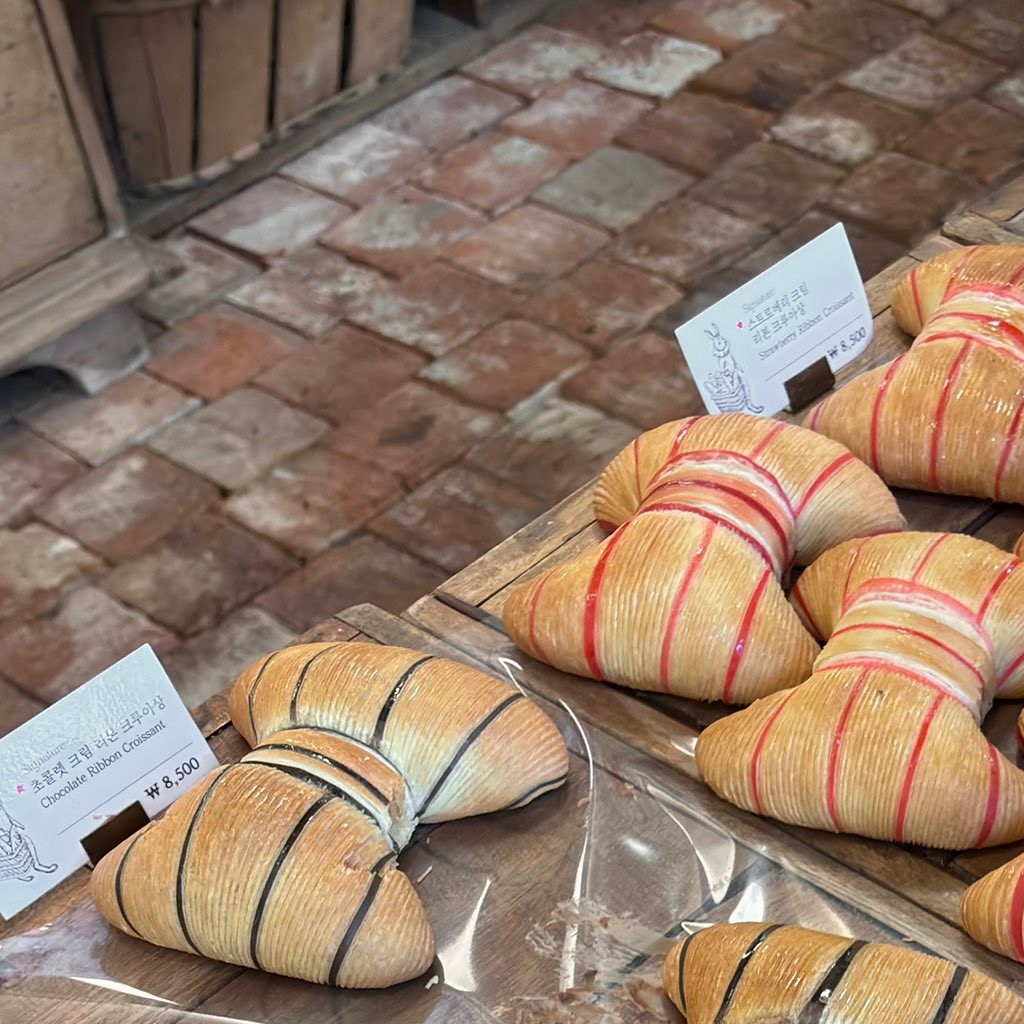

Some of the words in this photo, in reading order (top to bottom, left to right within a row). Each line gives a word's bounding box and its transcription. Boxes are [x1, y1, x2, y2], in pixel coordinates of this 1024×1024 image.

[792, 282, 809, 302] 크림
[752, 327, 771, 344] 리본
[772, 303, 805, 333] 크루아상
[759, 332, 797, 361] Strawberry
[798, 315, 823, 335] Ribbon
[823, 292, 855, 317] Croissant
[840, 327, 866, 352] 8,500
[23, 743, 67, 772] Signature
[31, 762, 68, 793] 초콜렛
[68, 744, 93, 768] 크림
[94, 730, 119, 749] 리본
[121, 695, 166, 733] 크루아상
[41, 773, 87, 809] Chocolate
[87, 751, 122, 777] Ribbon
[123, 720, 166, 753] Croissant
[163, 757, 199, 789] 8,500
